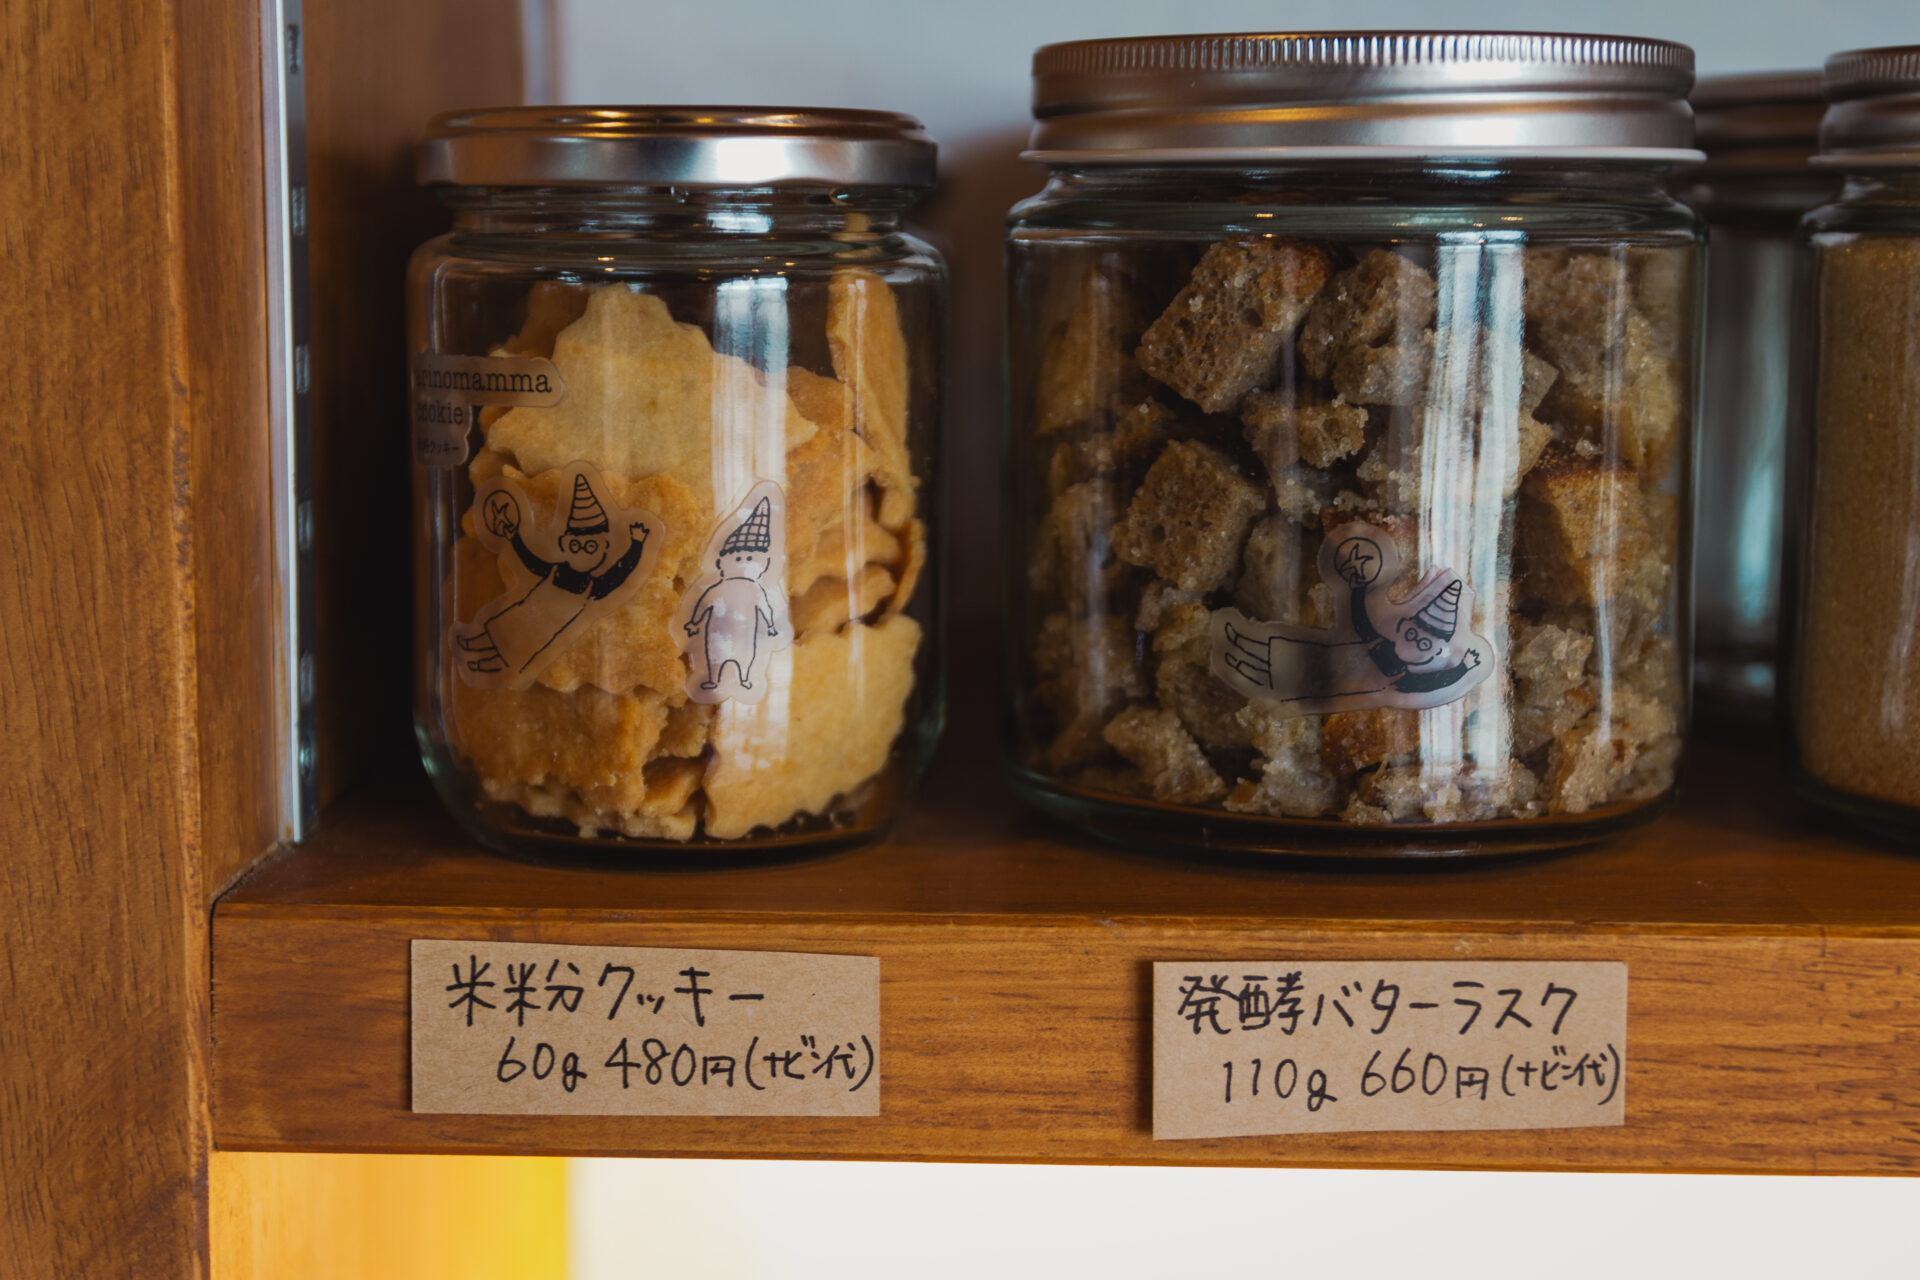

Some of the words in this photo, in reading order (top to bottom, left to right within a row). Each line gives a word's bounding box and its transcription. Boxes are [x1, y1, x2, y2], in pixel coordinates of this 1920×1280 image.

[1177, 971, 1578, 1036] 発酵バターラスク
[496, 1036, 588, 1093] 60g
[1222, 1058, 1338, 1112] 110g
